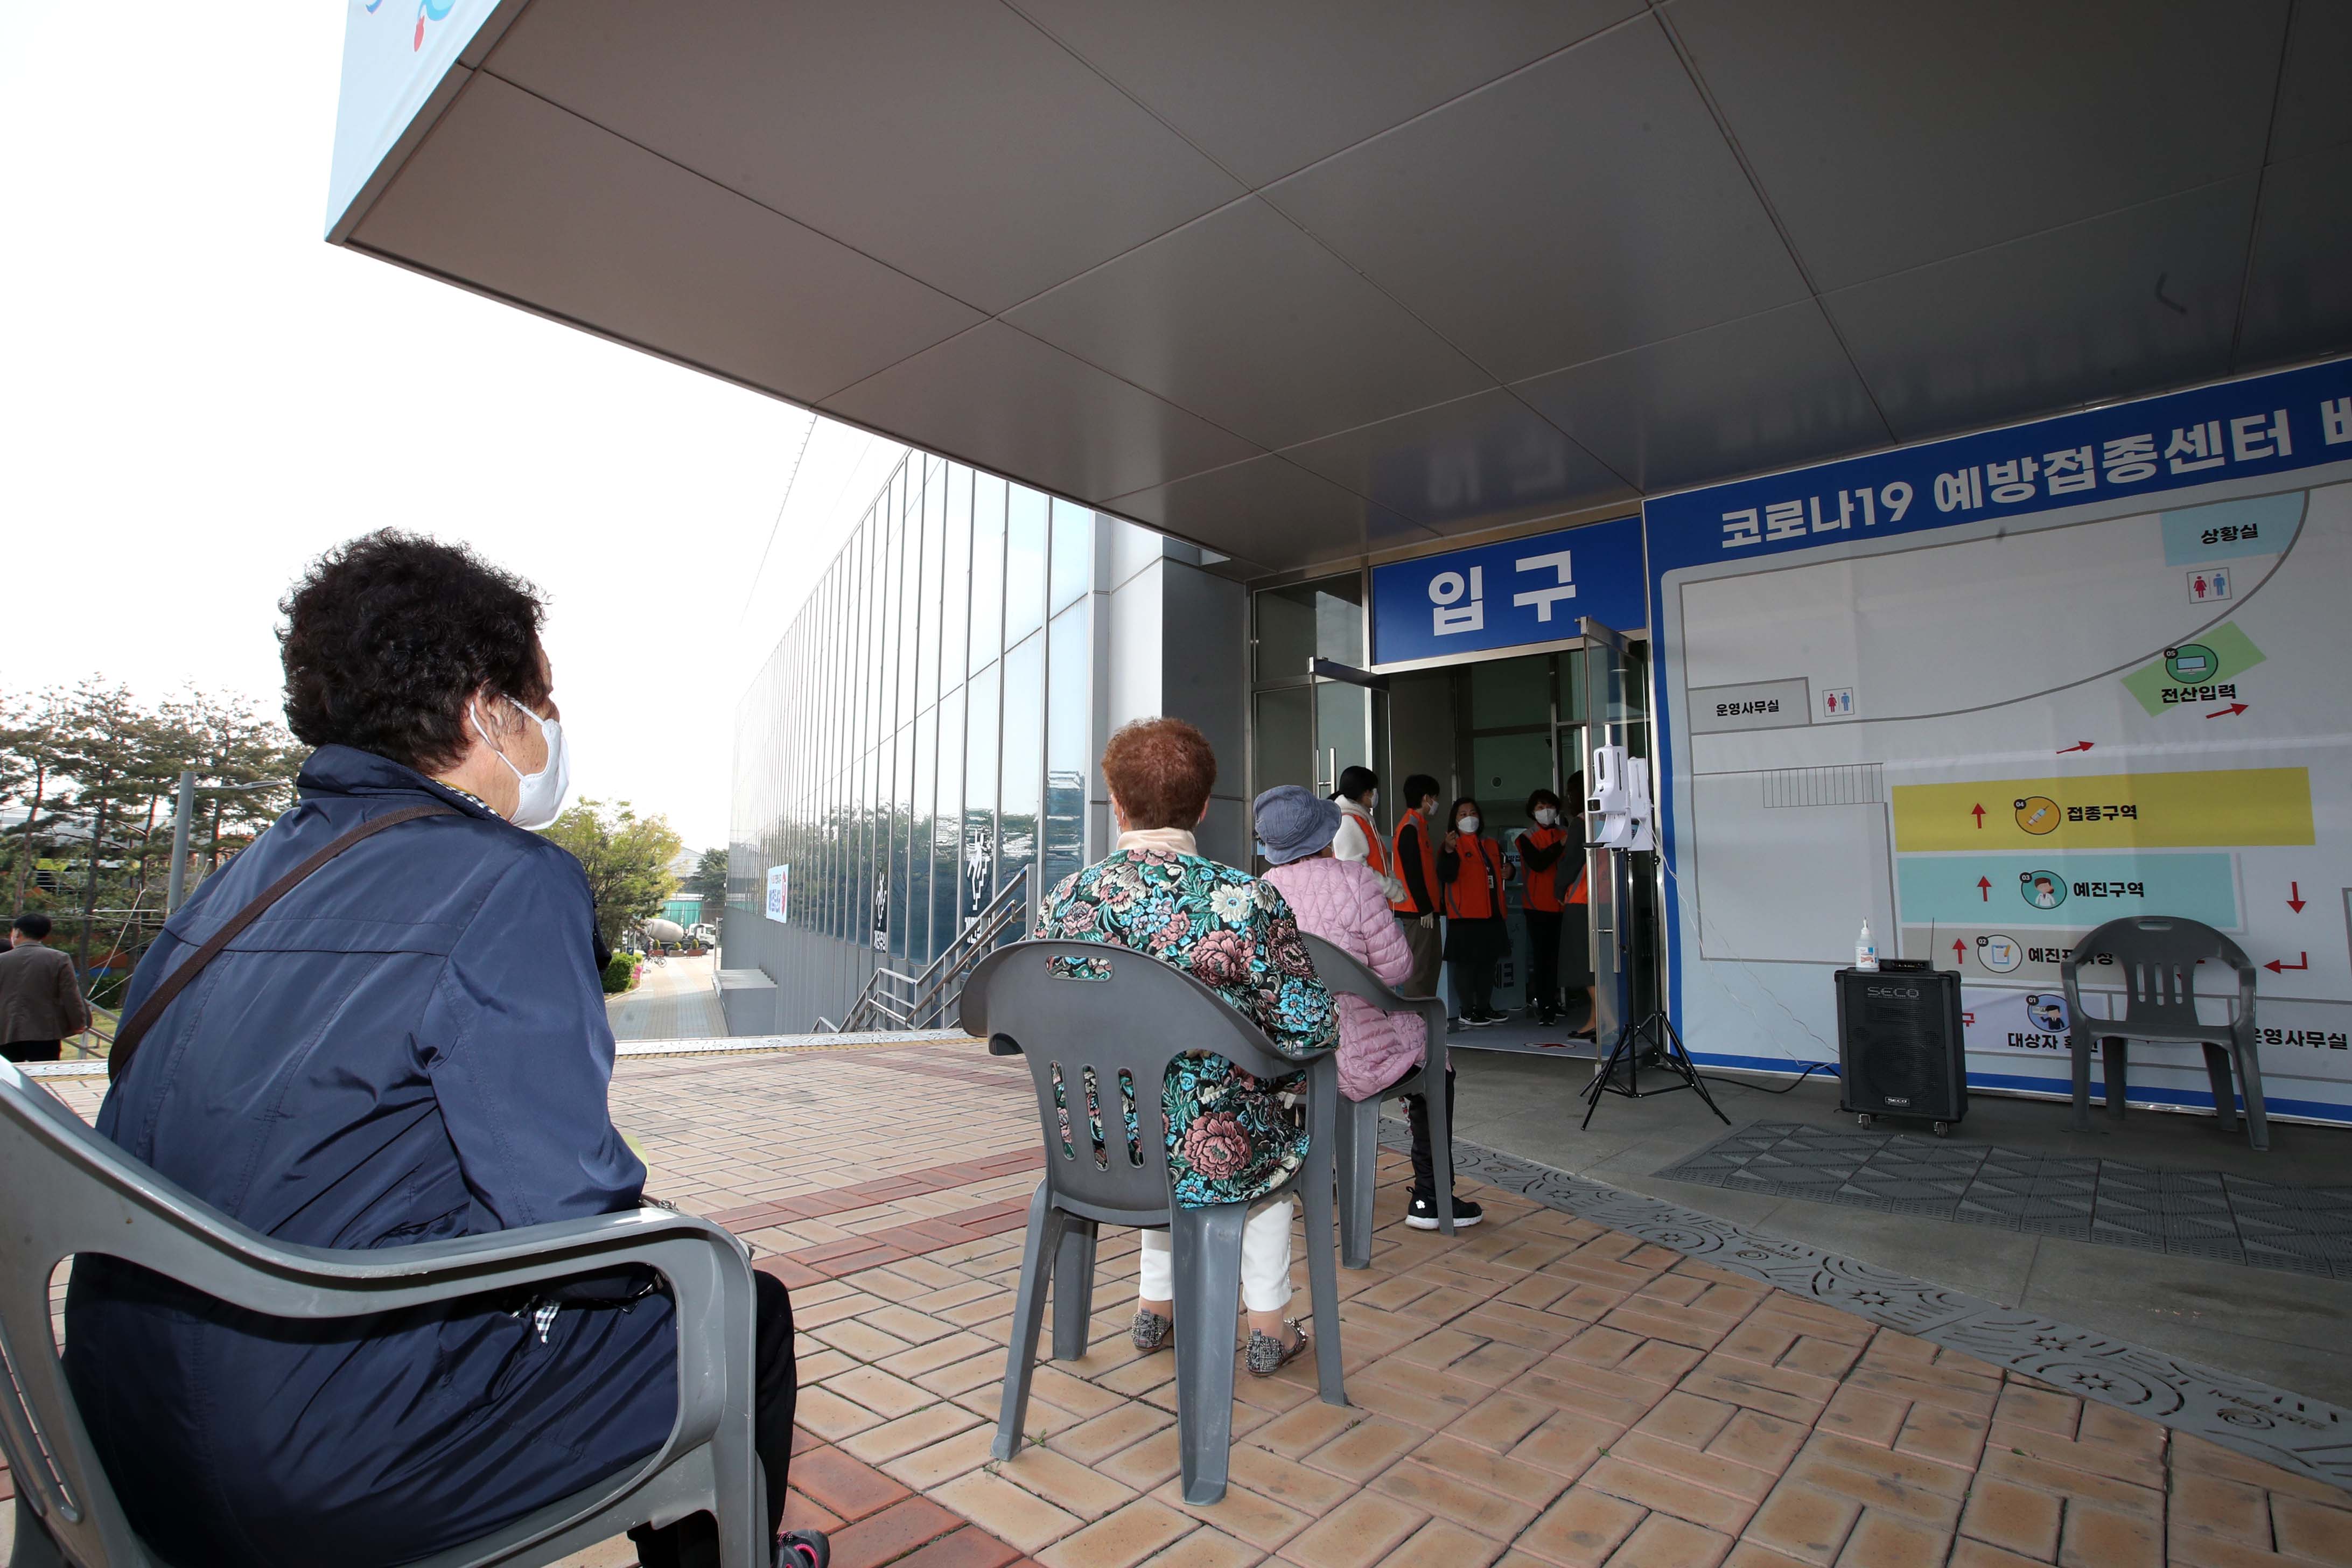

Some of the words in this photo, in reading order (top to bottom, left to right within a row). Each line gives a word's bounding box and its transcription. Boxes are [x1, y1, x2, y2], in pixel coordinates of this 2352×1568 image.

[1722, 481, 1913, 548] 코로나19
[1934, 409, 2292, 512] 예방접종센터
[2201, 523, 2258, 544] 상황실
[2161, 684, 2236, 704] 전산입력
[1716, 699, 1779, 717] 운영사무실
[2067, 805, 2137, 822] 접종구역
[2073, 882, 2144, 898] 예진구역
[2028, 948, 2113, 965] 예진성
[1867, 986, 1919, 998] SECO
[2008, 1033, 2058, 1049] 대상자
